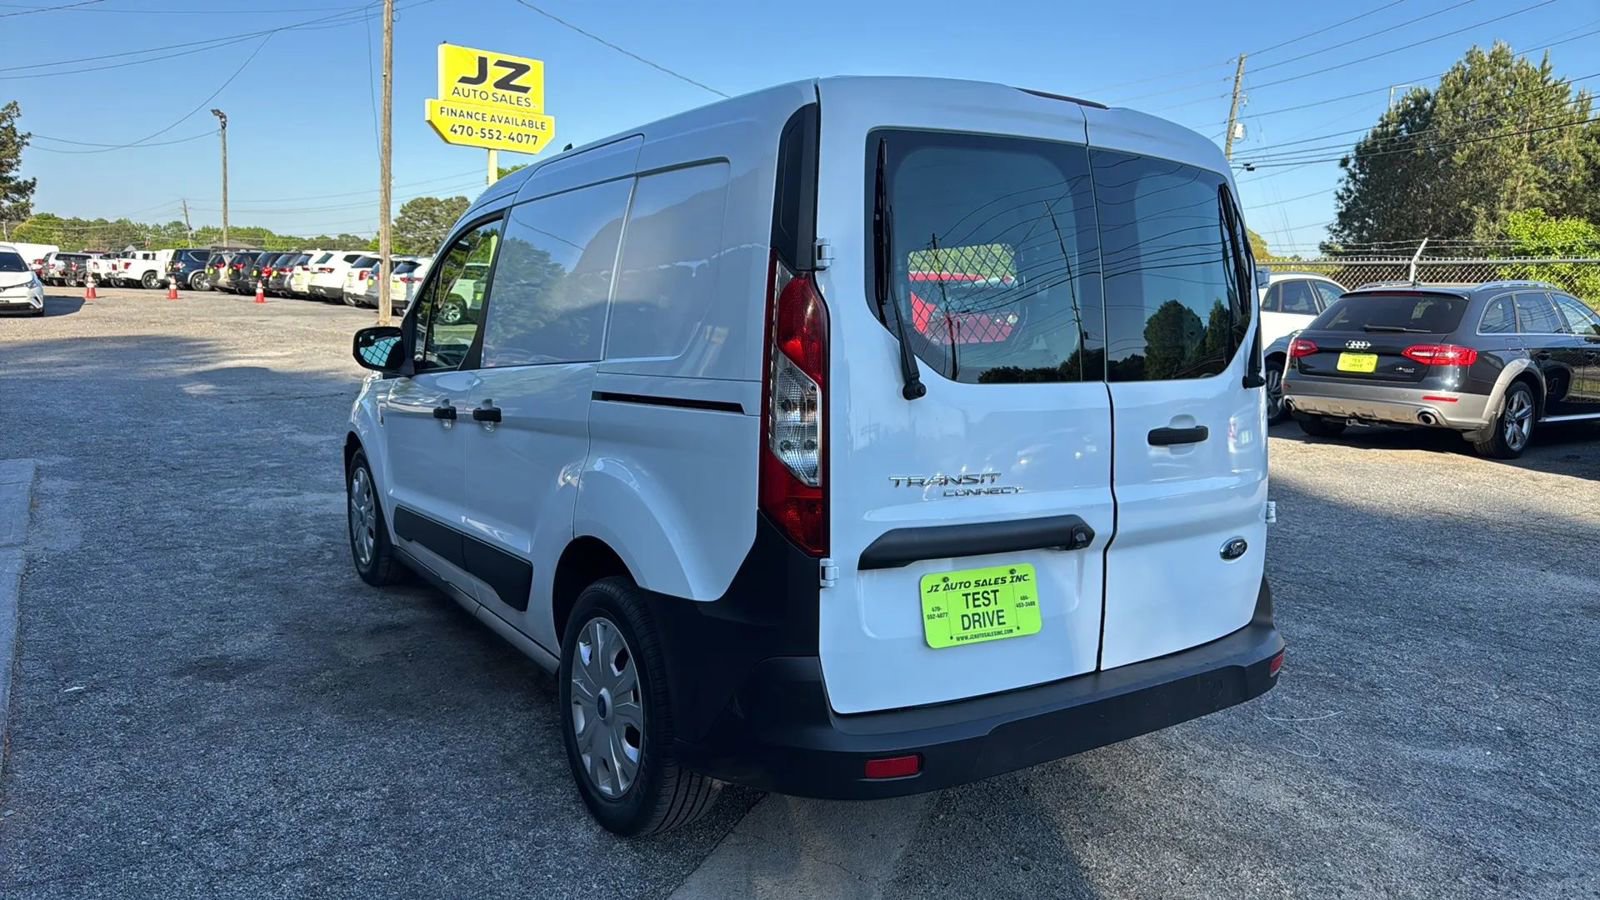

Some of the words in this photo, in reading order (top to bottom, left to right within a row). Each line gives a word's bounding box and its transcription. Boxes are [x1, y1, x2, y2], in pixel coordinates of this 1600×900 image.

[457, 56, 533, 94] JZ
[452, 86, 489, 101] AUTO
[492, 92, 531, 108] SALES
[440, 106, 487, 122] FINANCE
[490, 115, 546, 130] AVAILABLE
[450, 123, 538, 145] 470-552-4077
[888, 473, 1001, 488] TRANSIT
[943, 486, 1022, 497] CONNECT
[927, 584, 940, 593] JZ
[943, 580, 971, 591] AUTO
[974, 576, 1007, 588] SALES
[1009, 573, 1030, 583] INC.
[962, 589, 999, 609] TEST
[961, 609, 1006, 631] DRIVE
